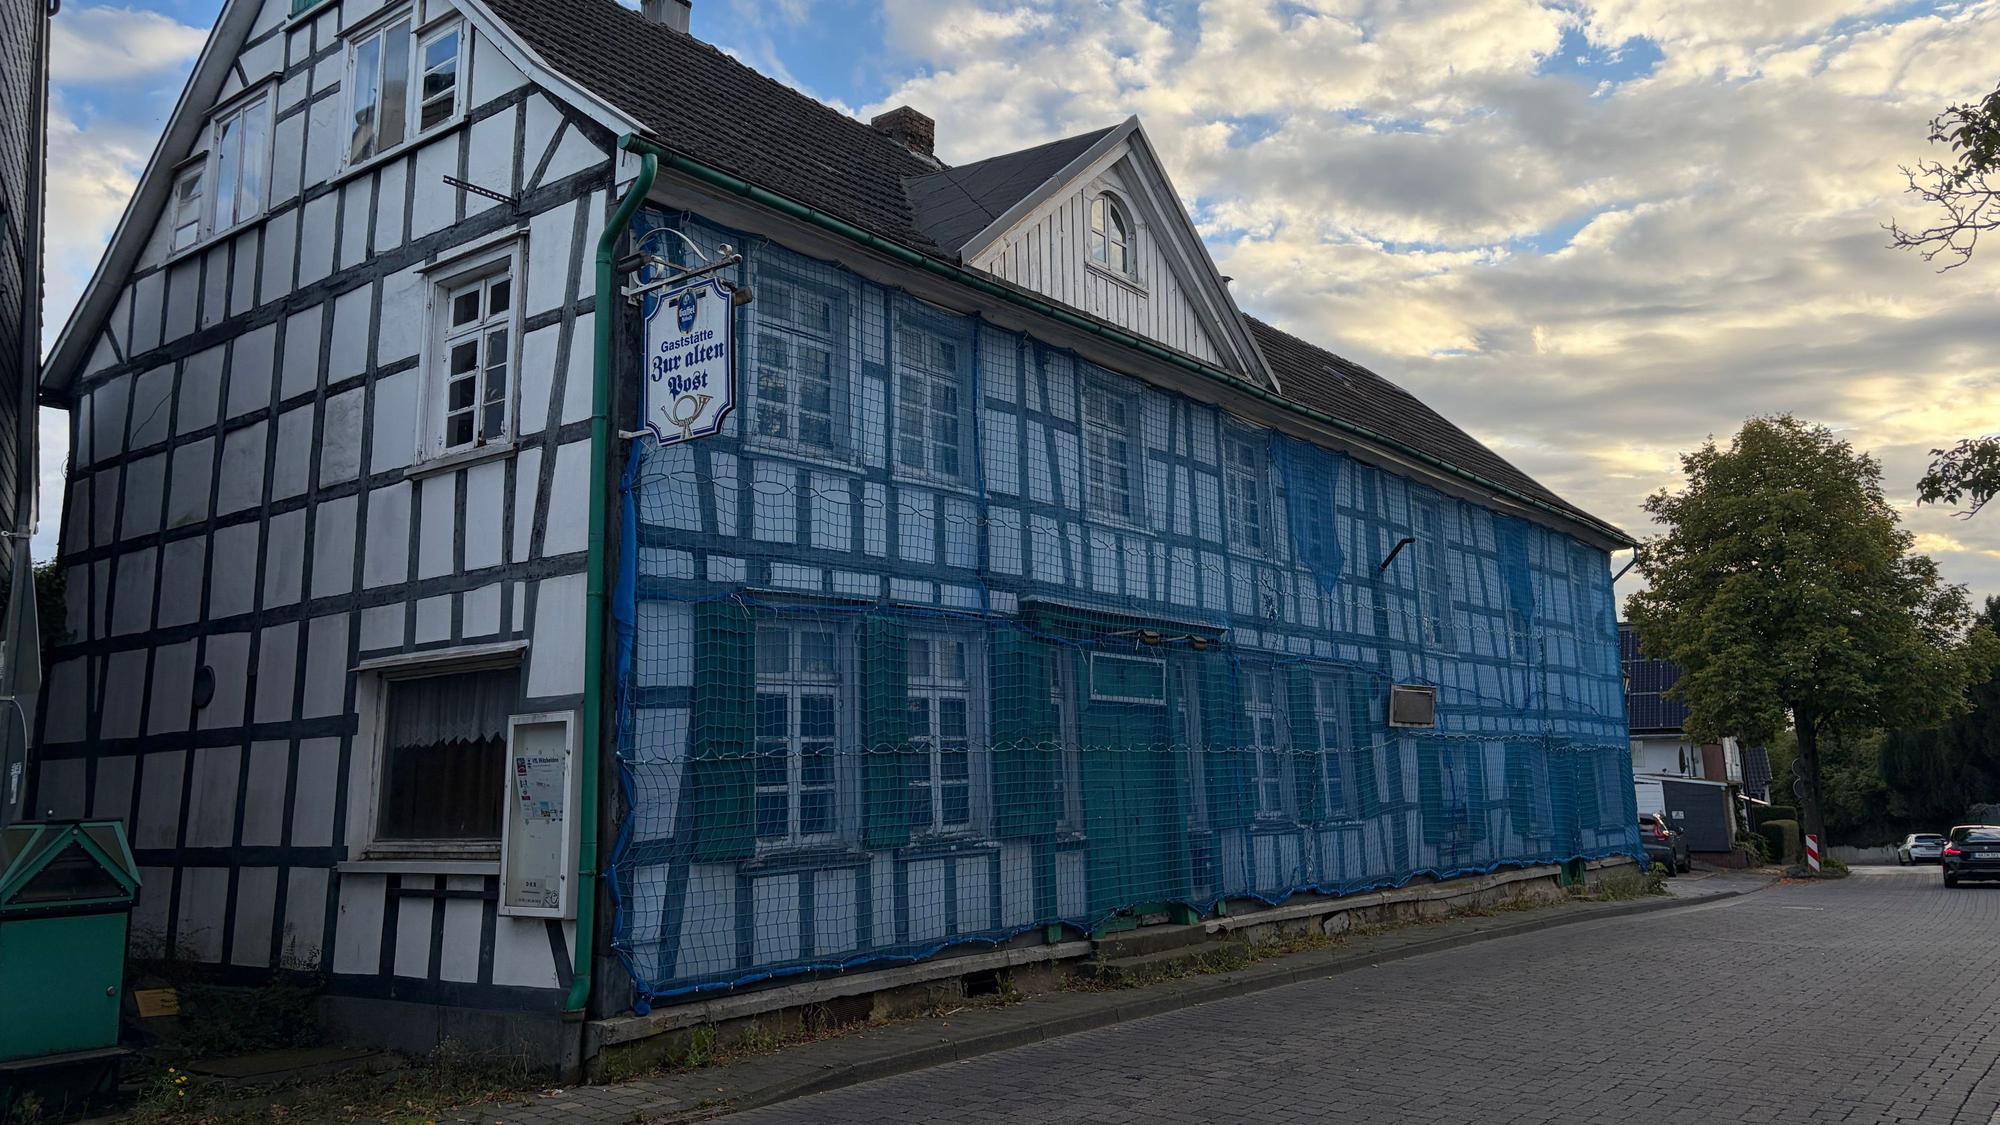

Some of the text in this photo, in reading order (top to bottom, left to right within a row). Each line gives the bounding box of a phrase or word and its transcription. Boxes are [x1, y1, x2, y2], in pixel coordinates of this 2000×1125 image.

[661, 329, 714, 353] Gaststätte
[651, 342, 724, 383] Zur alten
[667, 369, 708, 402] Post
